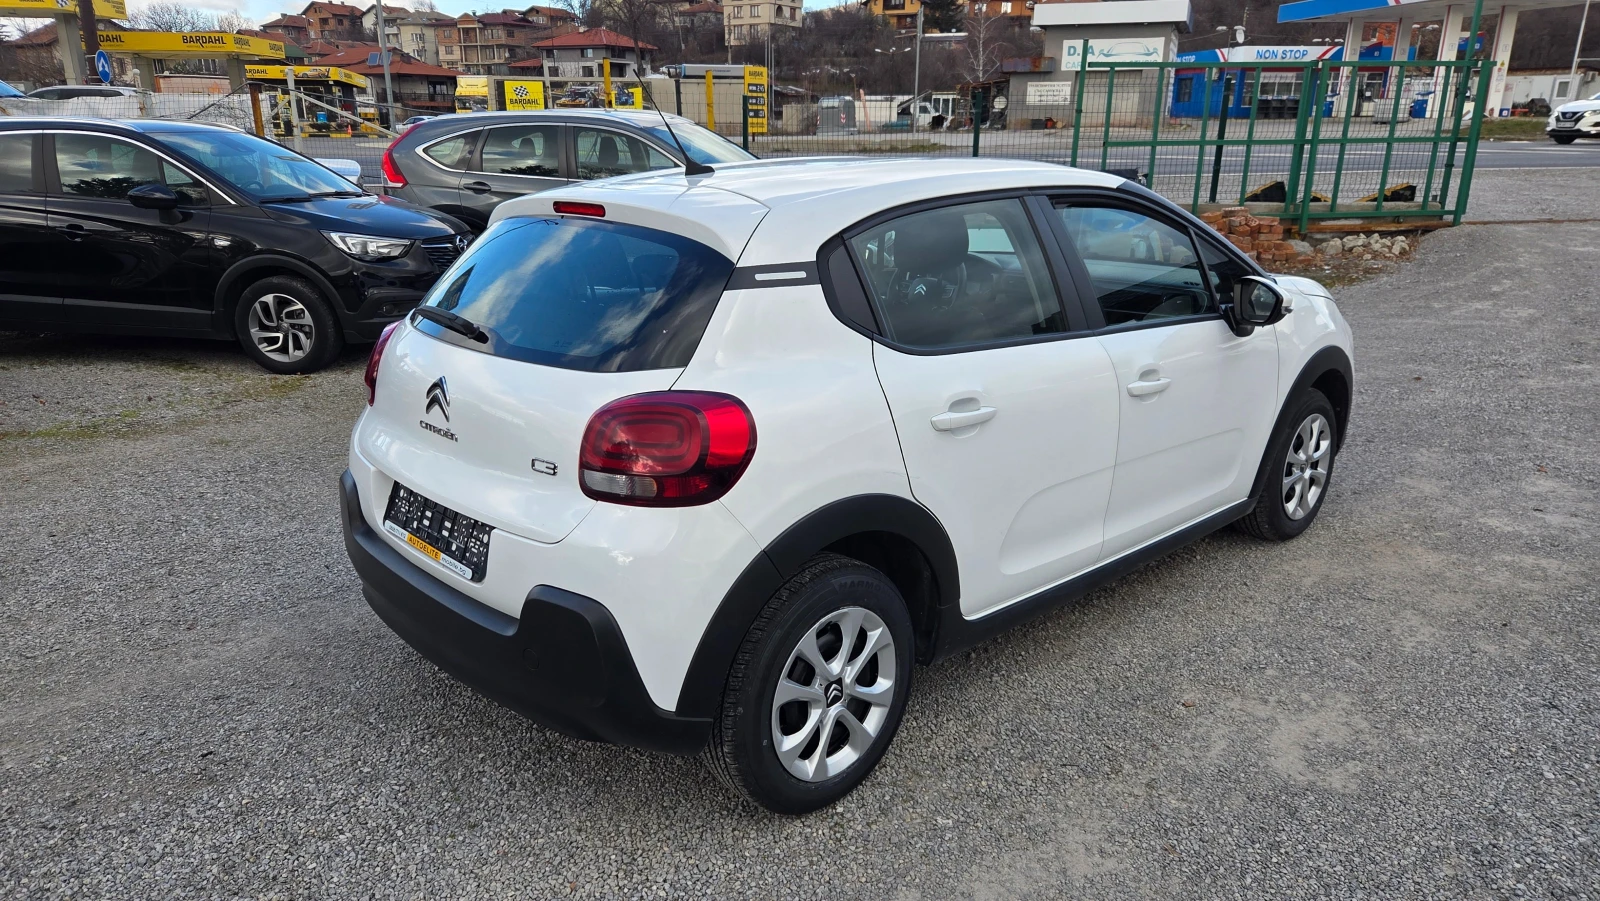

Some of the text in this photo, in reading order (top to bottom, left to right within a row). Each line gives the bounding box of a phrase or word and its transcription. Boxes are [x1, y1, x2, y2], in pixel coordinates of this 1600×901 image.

[80, 34, 124, 46] BDAHL
[182, 35, 227, 48] BARDAHL
[233, 36, 251, 48] BARDAHL
[1256, 49, 1308, 59] NON STOP
[245, 68, 268, 77] ARDAHL
[509, 98, 540, 109] BARDAHL
[419, 419, 459, 442] CITROËN
[531, 457, 558, 476] C3
[408, 536, 439, 559] AUTOELITE
